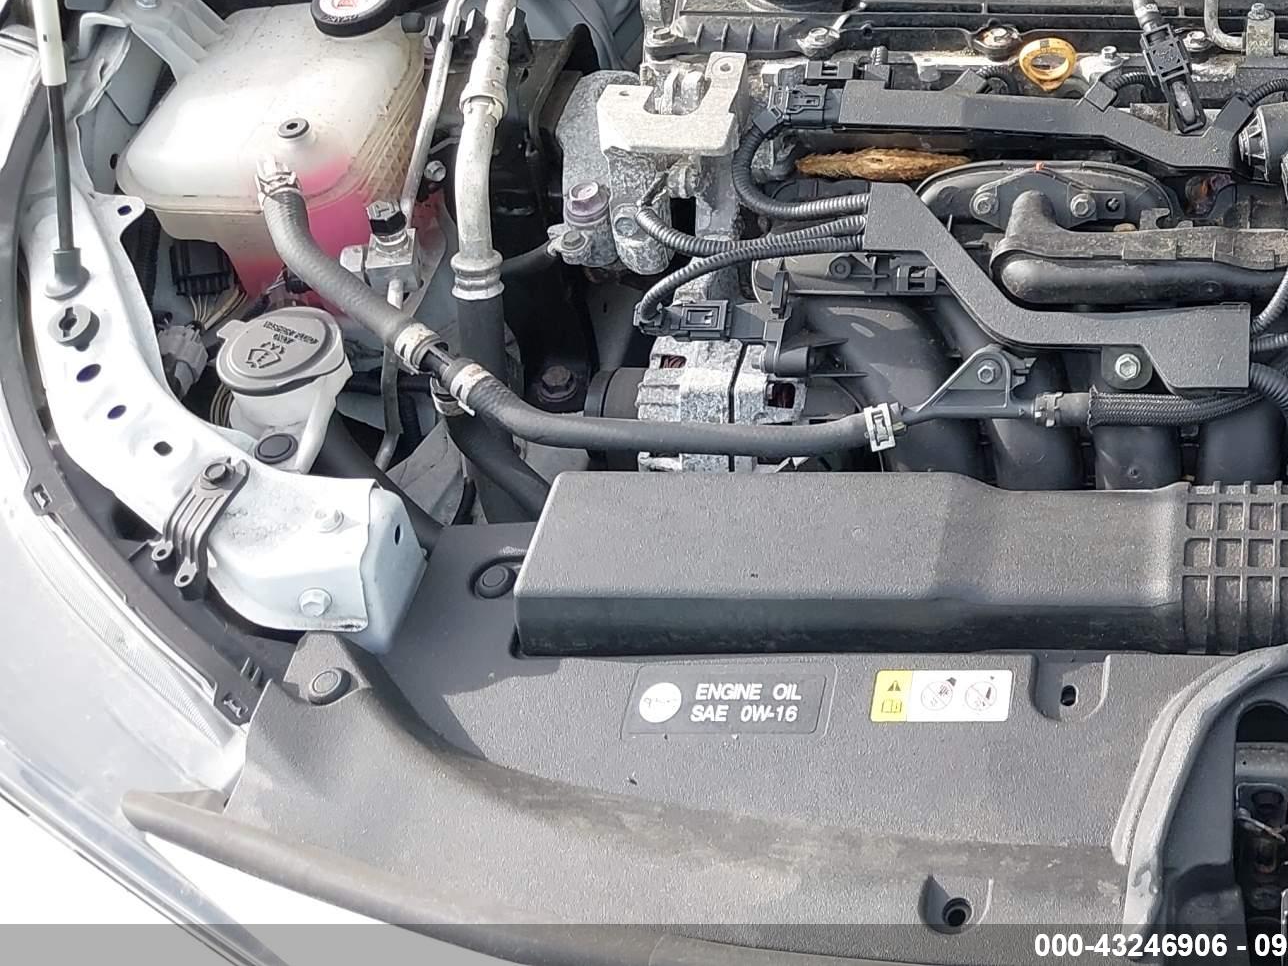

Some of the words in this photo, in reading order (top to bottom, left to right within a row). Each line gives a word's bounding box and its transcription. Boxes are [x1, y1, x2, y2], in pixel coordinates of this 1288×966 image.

[695, 683, 763, 701] ENGINE
[772, 683, 802, 701] OIL
[690, 704, 729, 722] SAE
[740, 705, 798, 722] 0W-16
